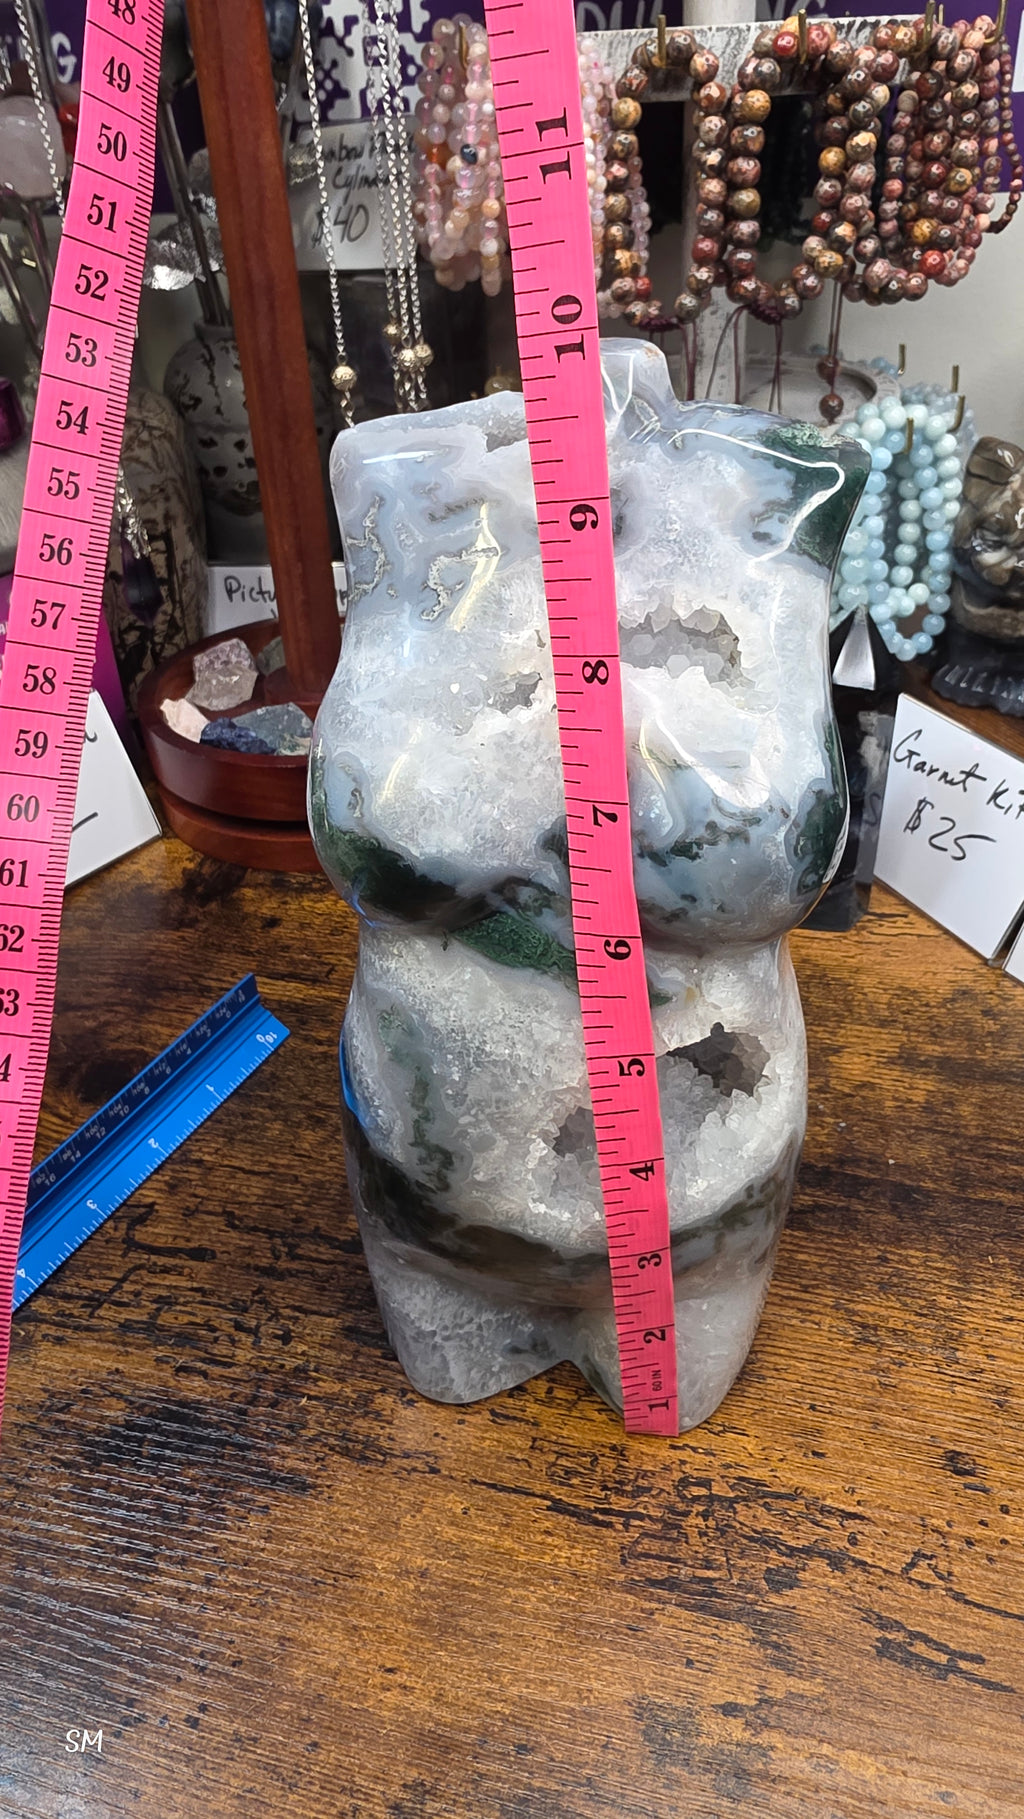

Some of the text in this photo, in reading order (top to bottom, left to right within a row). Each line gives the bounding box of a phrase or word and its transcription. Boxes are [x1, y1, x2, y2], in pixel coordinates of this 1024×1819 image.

[102, 56, 131, 93] 49
[97, 122, 128, 162] 50
[535, 107, 572, 184] 11
[87, 193, 117, 233] 51
[75, 264, 109, 301] 52
[551, 294, 586, 364] 10
[65, 332, 98, 367] 53
[56, 400, 89, 435] 54
[47, 467, 80, 500] 55
[569, 503, 599, 531] 9
[39, 533, 73, 566] 56
[31, 599, 66, 630] 57
[22, 664, 57, 695] 58
[581, 658, 609, 686] 8
[14, 729, 49, 759] 59
[893, 729, 987, 793] Garnet
[6, 794, 40, 823] 60
[592, 804, 618, 827] 7
[903, 797, 997, 861] $25
[0, 858, 29, 888] 61
[604, 939, 632, 960] 6
[617, 1058, 645, 1077] 5
[629, 1161, 655, 1182] 4
[86, 1199, 98, 1210] 3
[637, 1253, 662, 1270] 3
[643, 1328, 666, 1344] 2
[647, 1399, 669, 1412] 1
